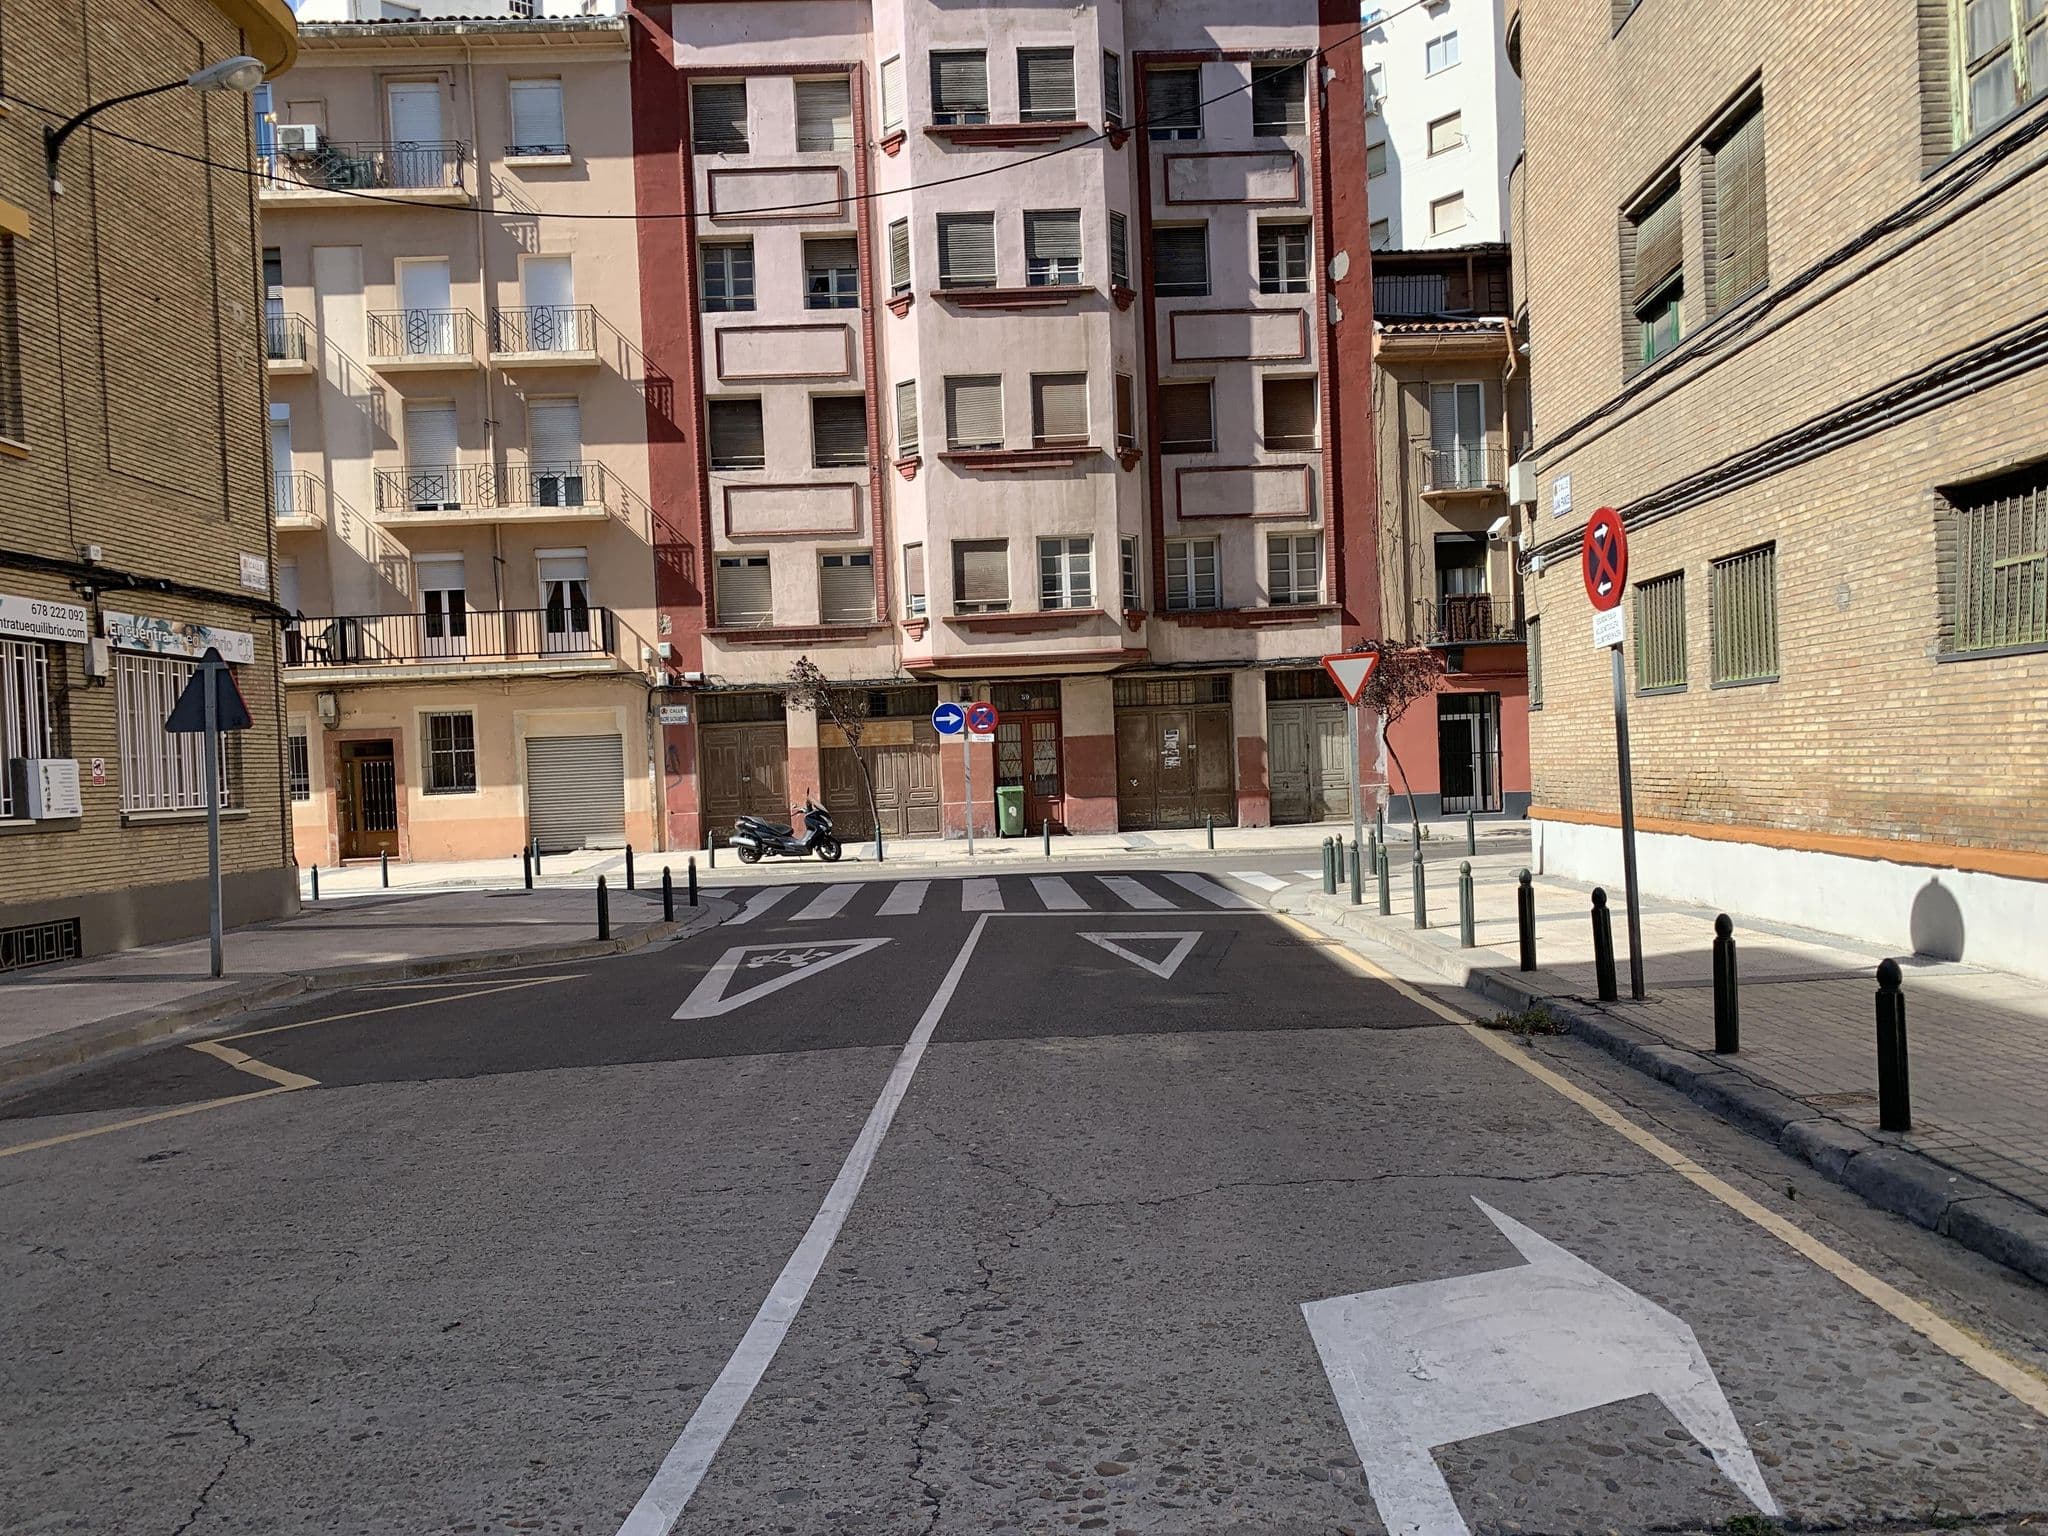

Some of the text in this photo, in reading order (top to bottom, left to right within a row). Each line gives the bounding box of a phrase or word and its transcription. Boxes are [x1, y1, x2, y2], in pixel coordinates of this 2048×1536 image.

[31, 603, 84, 621] 678 222 092
[109, 620, 169, 643] Encuentra
